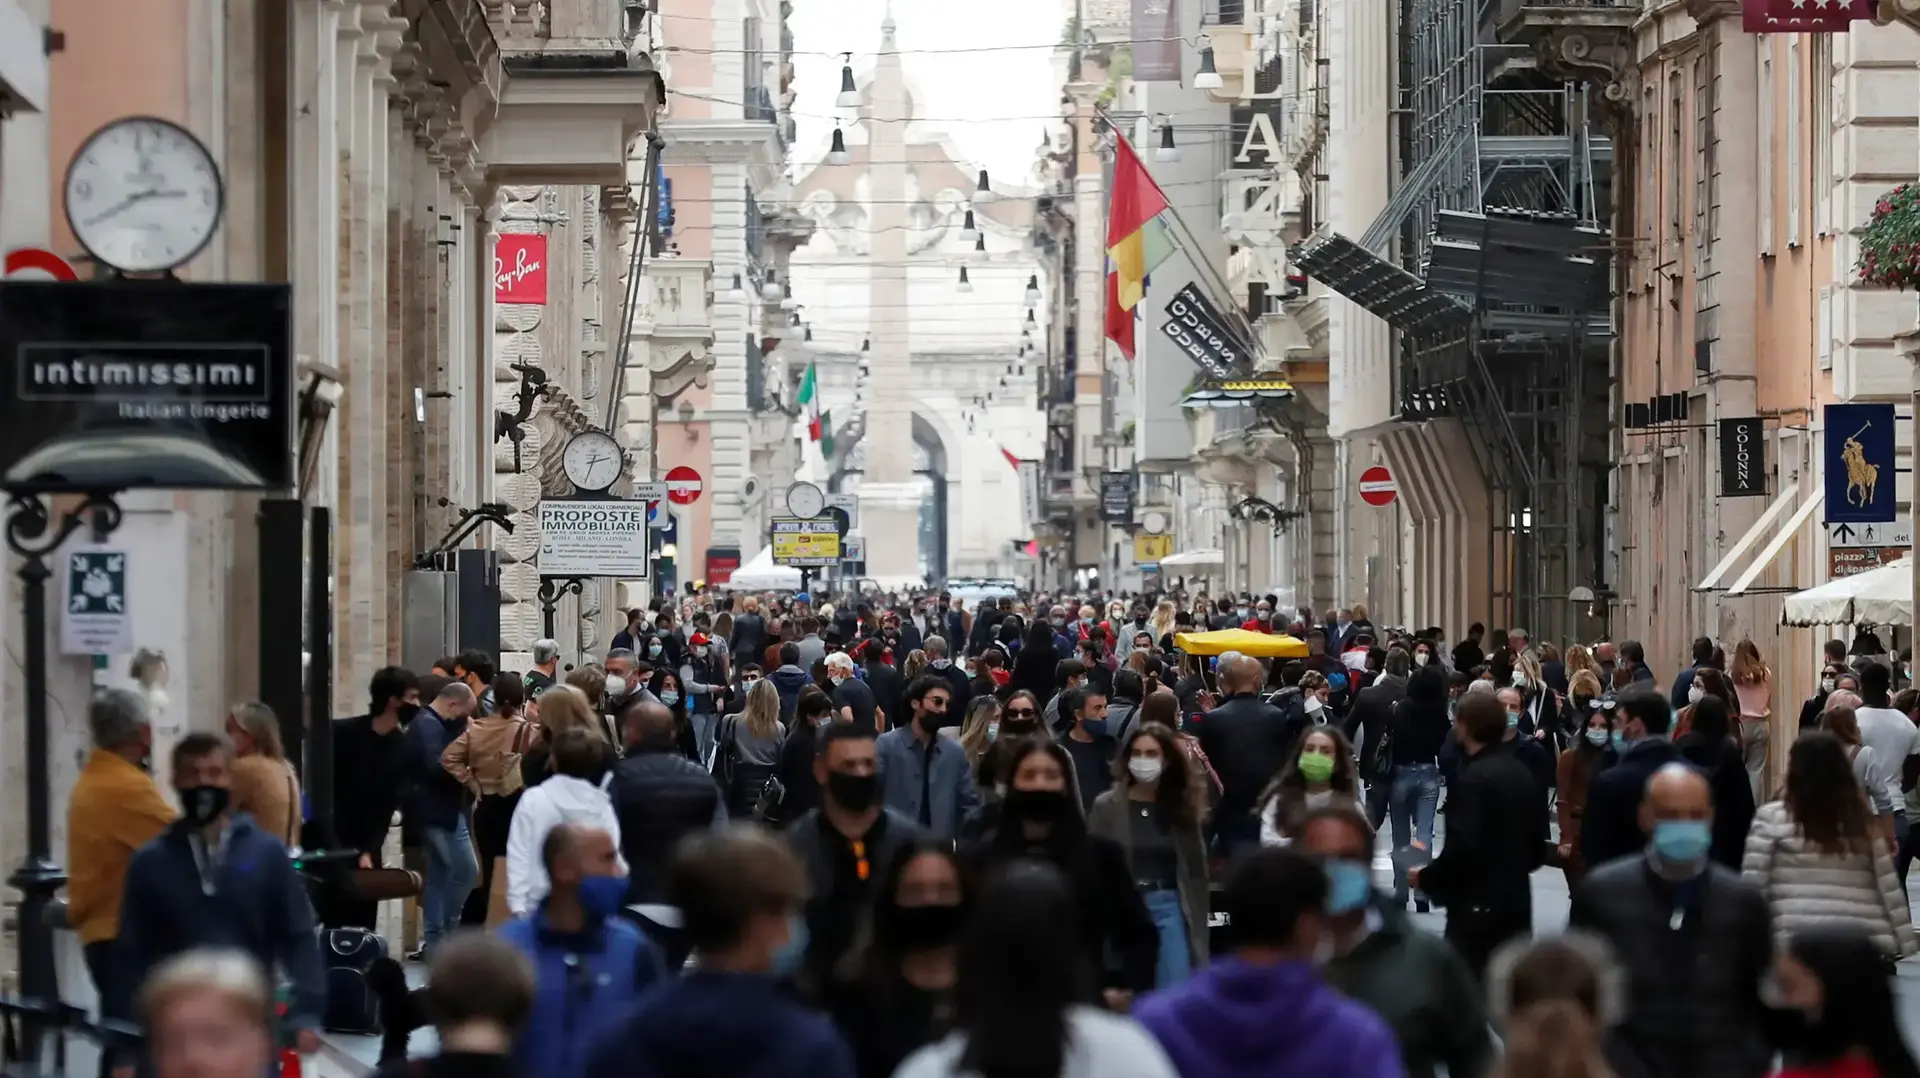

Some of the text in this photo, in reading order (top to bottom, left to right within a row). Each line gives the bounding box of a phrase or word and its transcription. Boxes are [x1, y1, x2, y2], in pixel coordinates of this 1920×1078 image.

[1171, 300, 1235, 363] GUESS
[1165, 322, 1227, 377] GUESS
[34, 359, 255, 385] intimissimi
[118, 402, 270, 422] Italian lingerie
[1736, 424, 1749, 489] COLONNA
[541, 511, 640, 522] PROPOSTE
[541, 521, 640, 531] IMMOBILIARI
[1894, 533, 1910, 542] del
[1834, 552, 1865, 563] piazza
[1834, 564, 1844, 574] di
